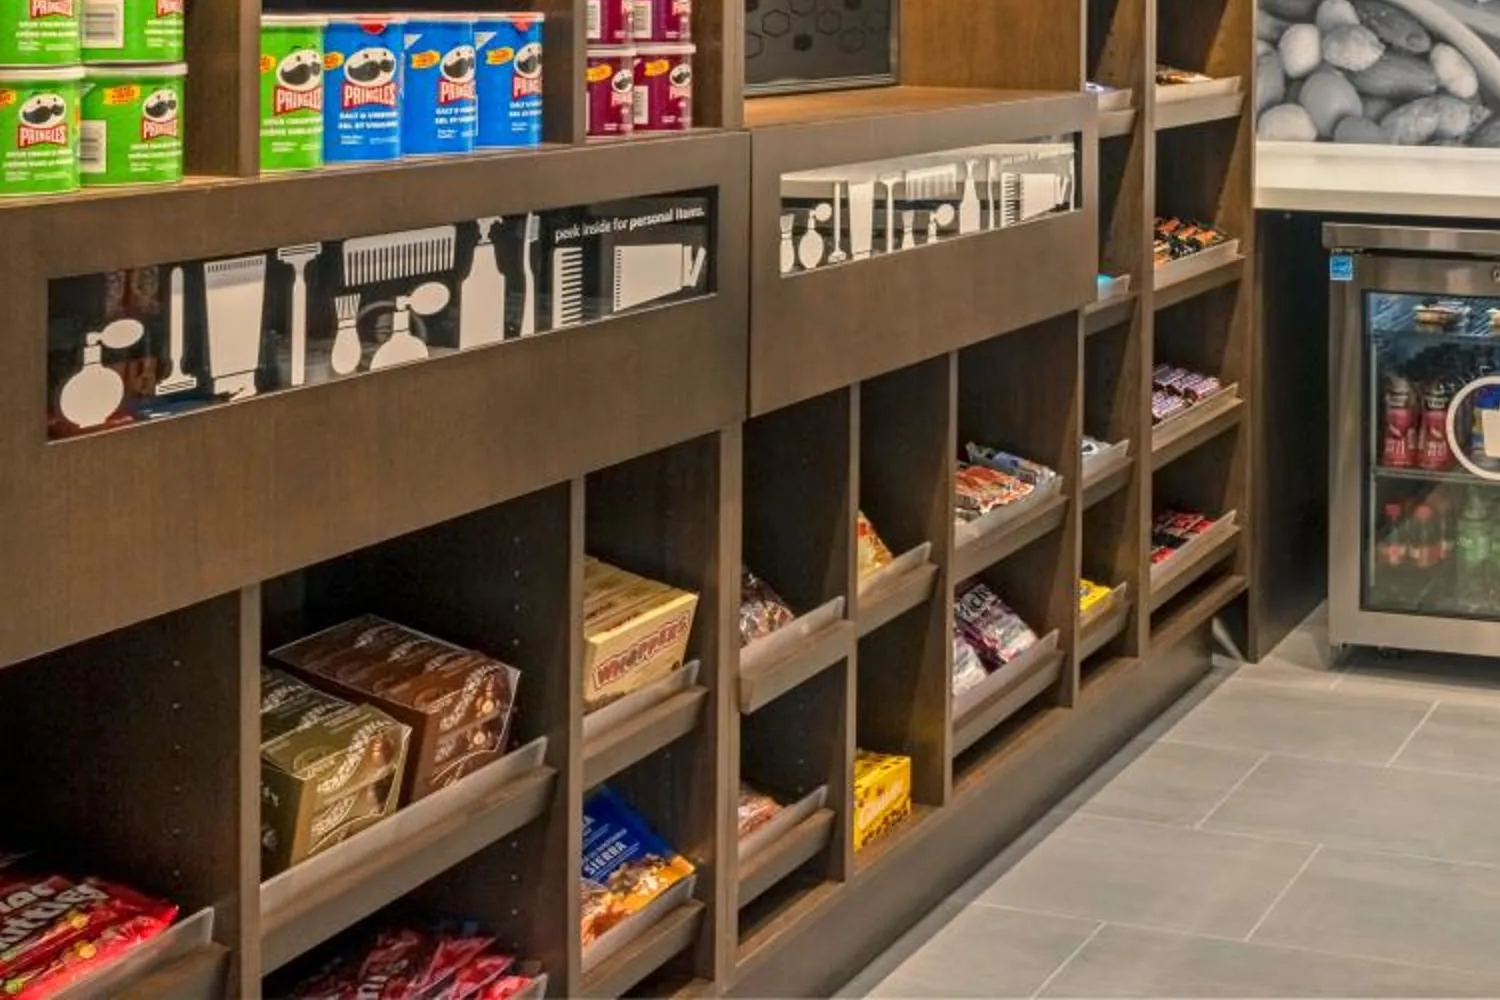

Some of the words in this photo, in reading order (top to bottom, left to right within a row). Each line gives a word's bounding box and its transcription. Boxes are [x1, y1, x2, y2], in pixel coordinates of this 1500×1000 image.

[341, 84, 397, 109] PRINGLES
[554, 223, 581, 244] peek
[582, 219, 612, 237] inside
[613, 217, 629, 231] for
[629, 208, 674, 231] personal
[584, 841, 629, 876] SIERRA
